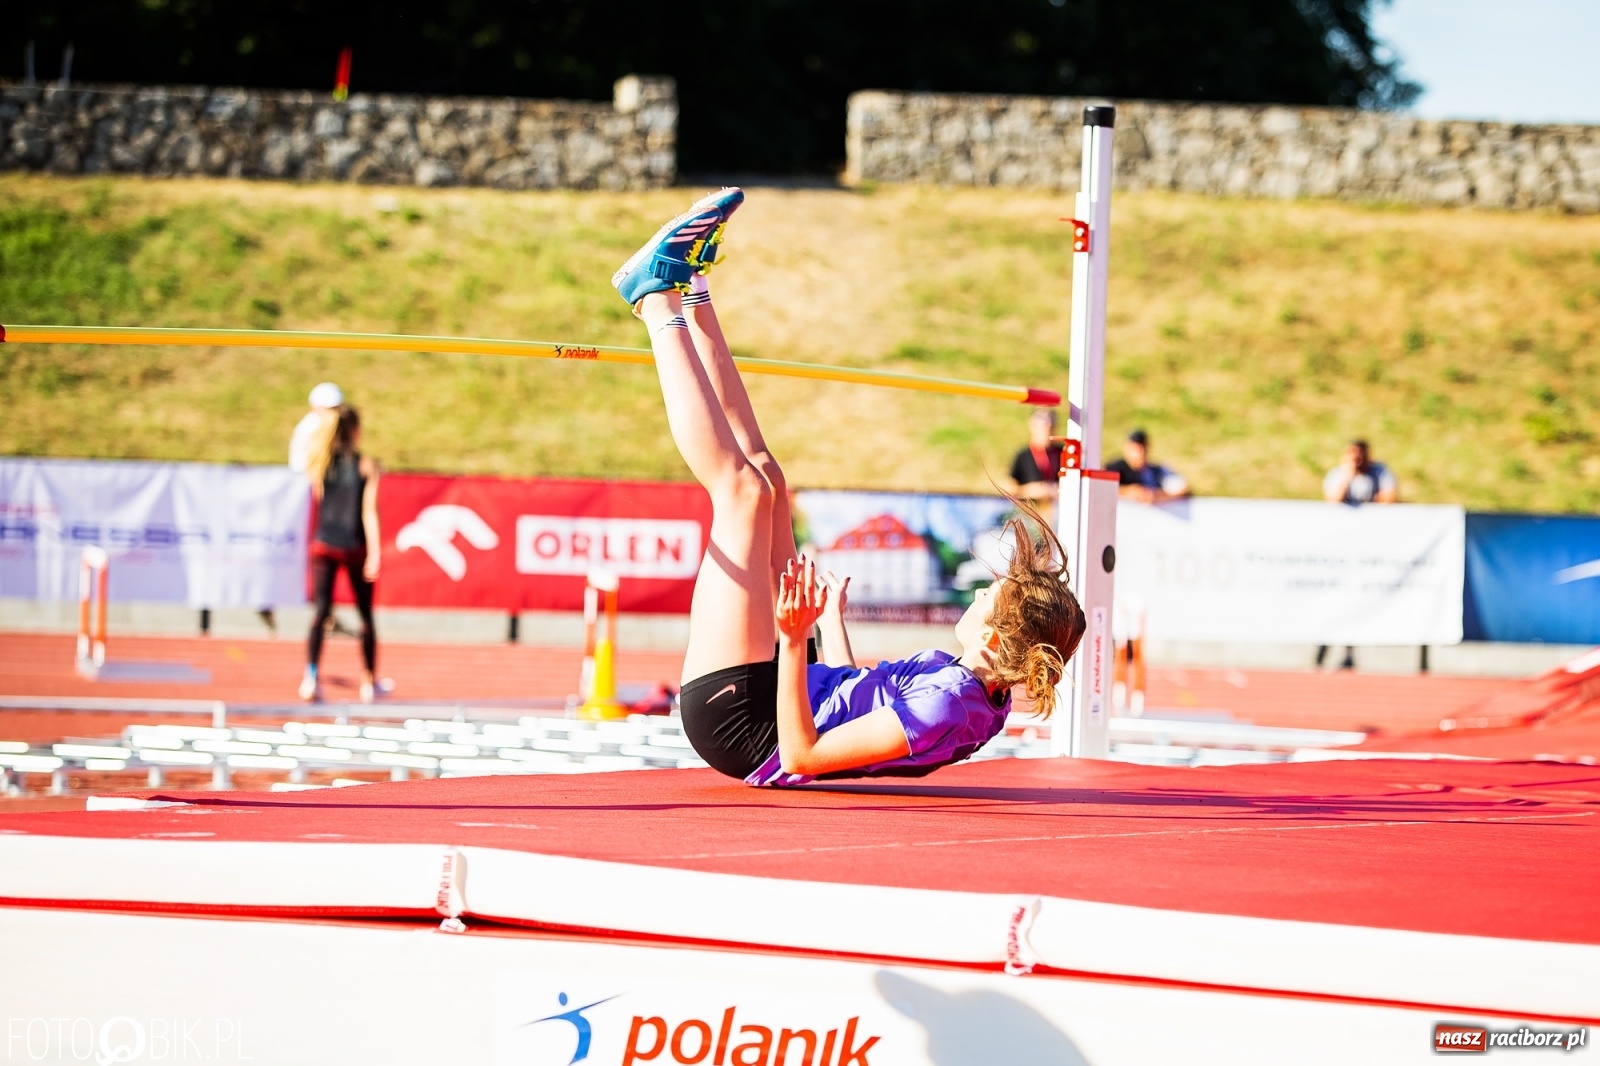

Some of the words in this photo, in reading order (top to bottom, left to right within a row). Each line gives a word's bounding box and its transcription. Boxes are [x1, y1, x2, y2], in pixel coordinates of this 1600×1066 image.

[563, 346, 599, 360] polanik
[534, 531, 682, 562] ORLEN
[622, 1006, 882, 1066] polanik
